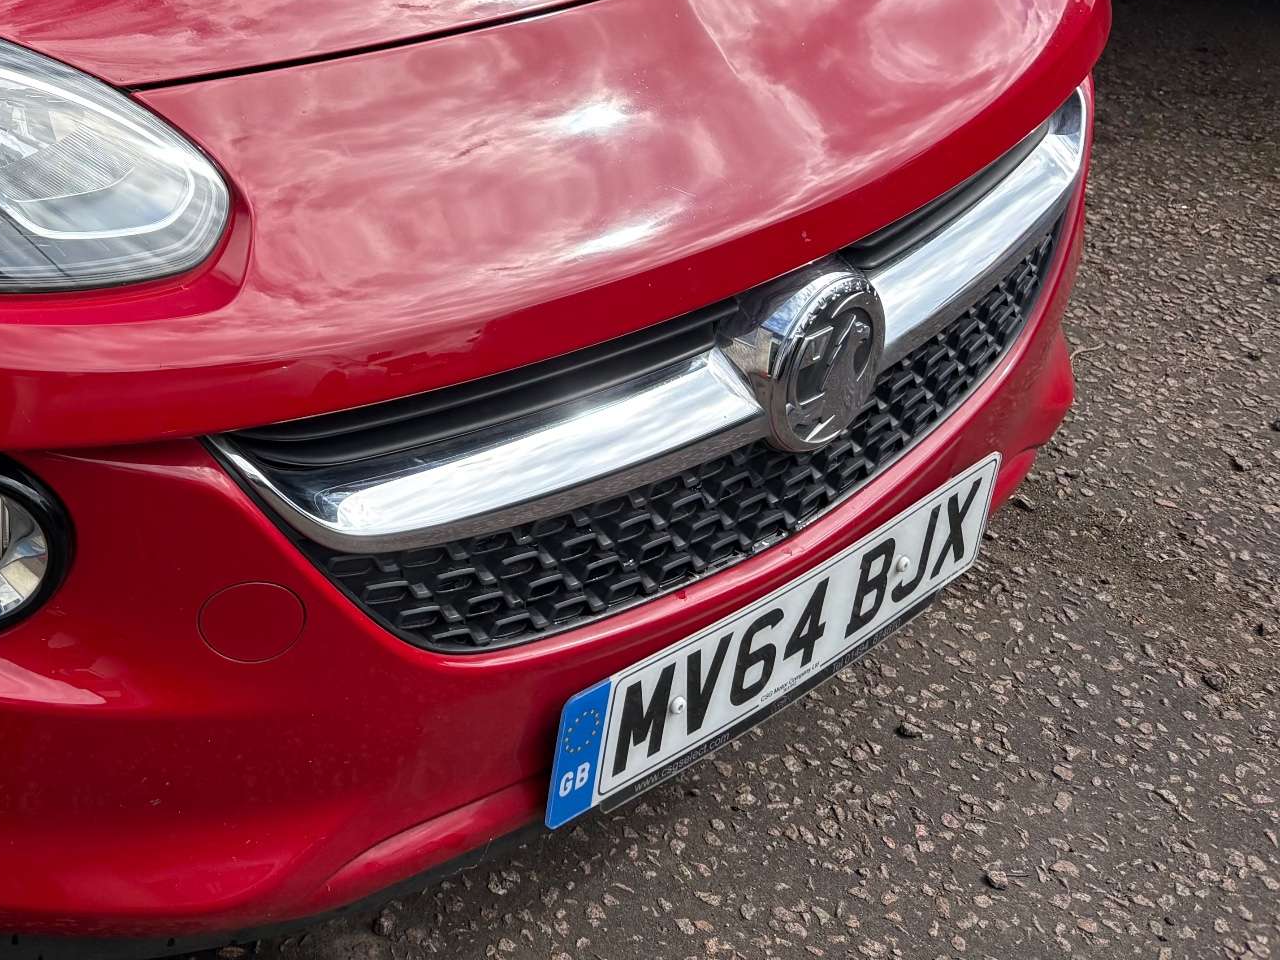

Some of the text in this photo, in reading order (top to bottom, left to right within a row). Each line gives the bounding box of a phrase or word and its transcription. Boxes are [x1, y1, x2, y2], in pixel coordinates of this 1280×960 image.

[612, 478, 981, 778] MV64 BJX
[559, 761, 591, 797] GB
